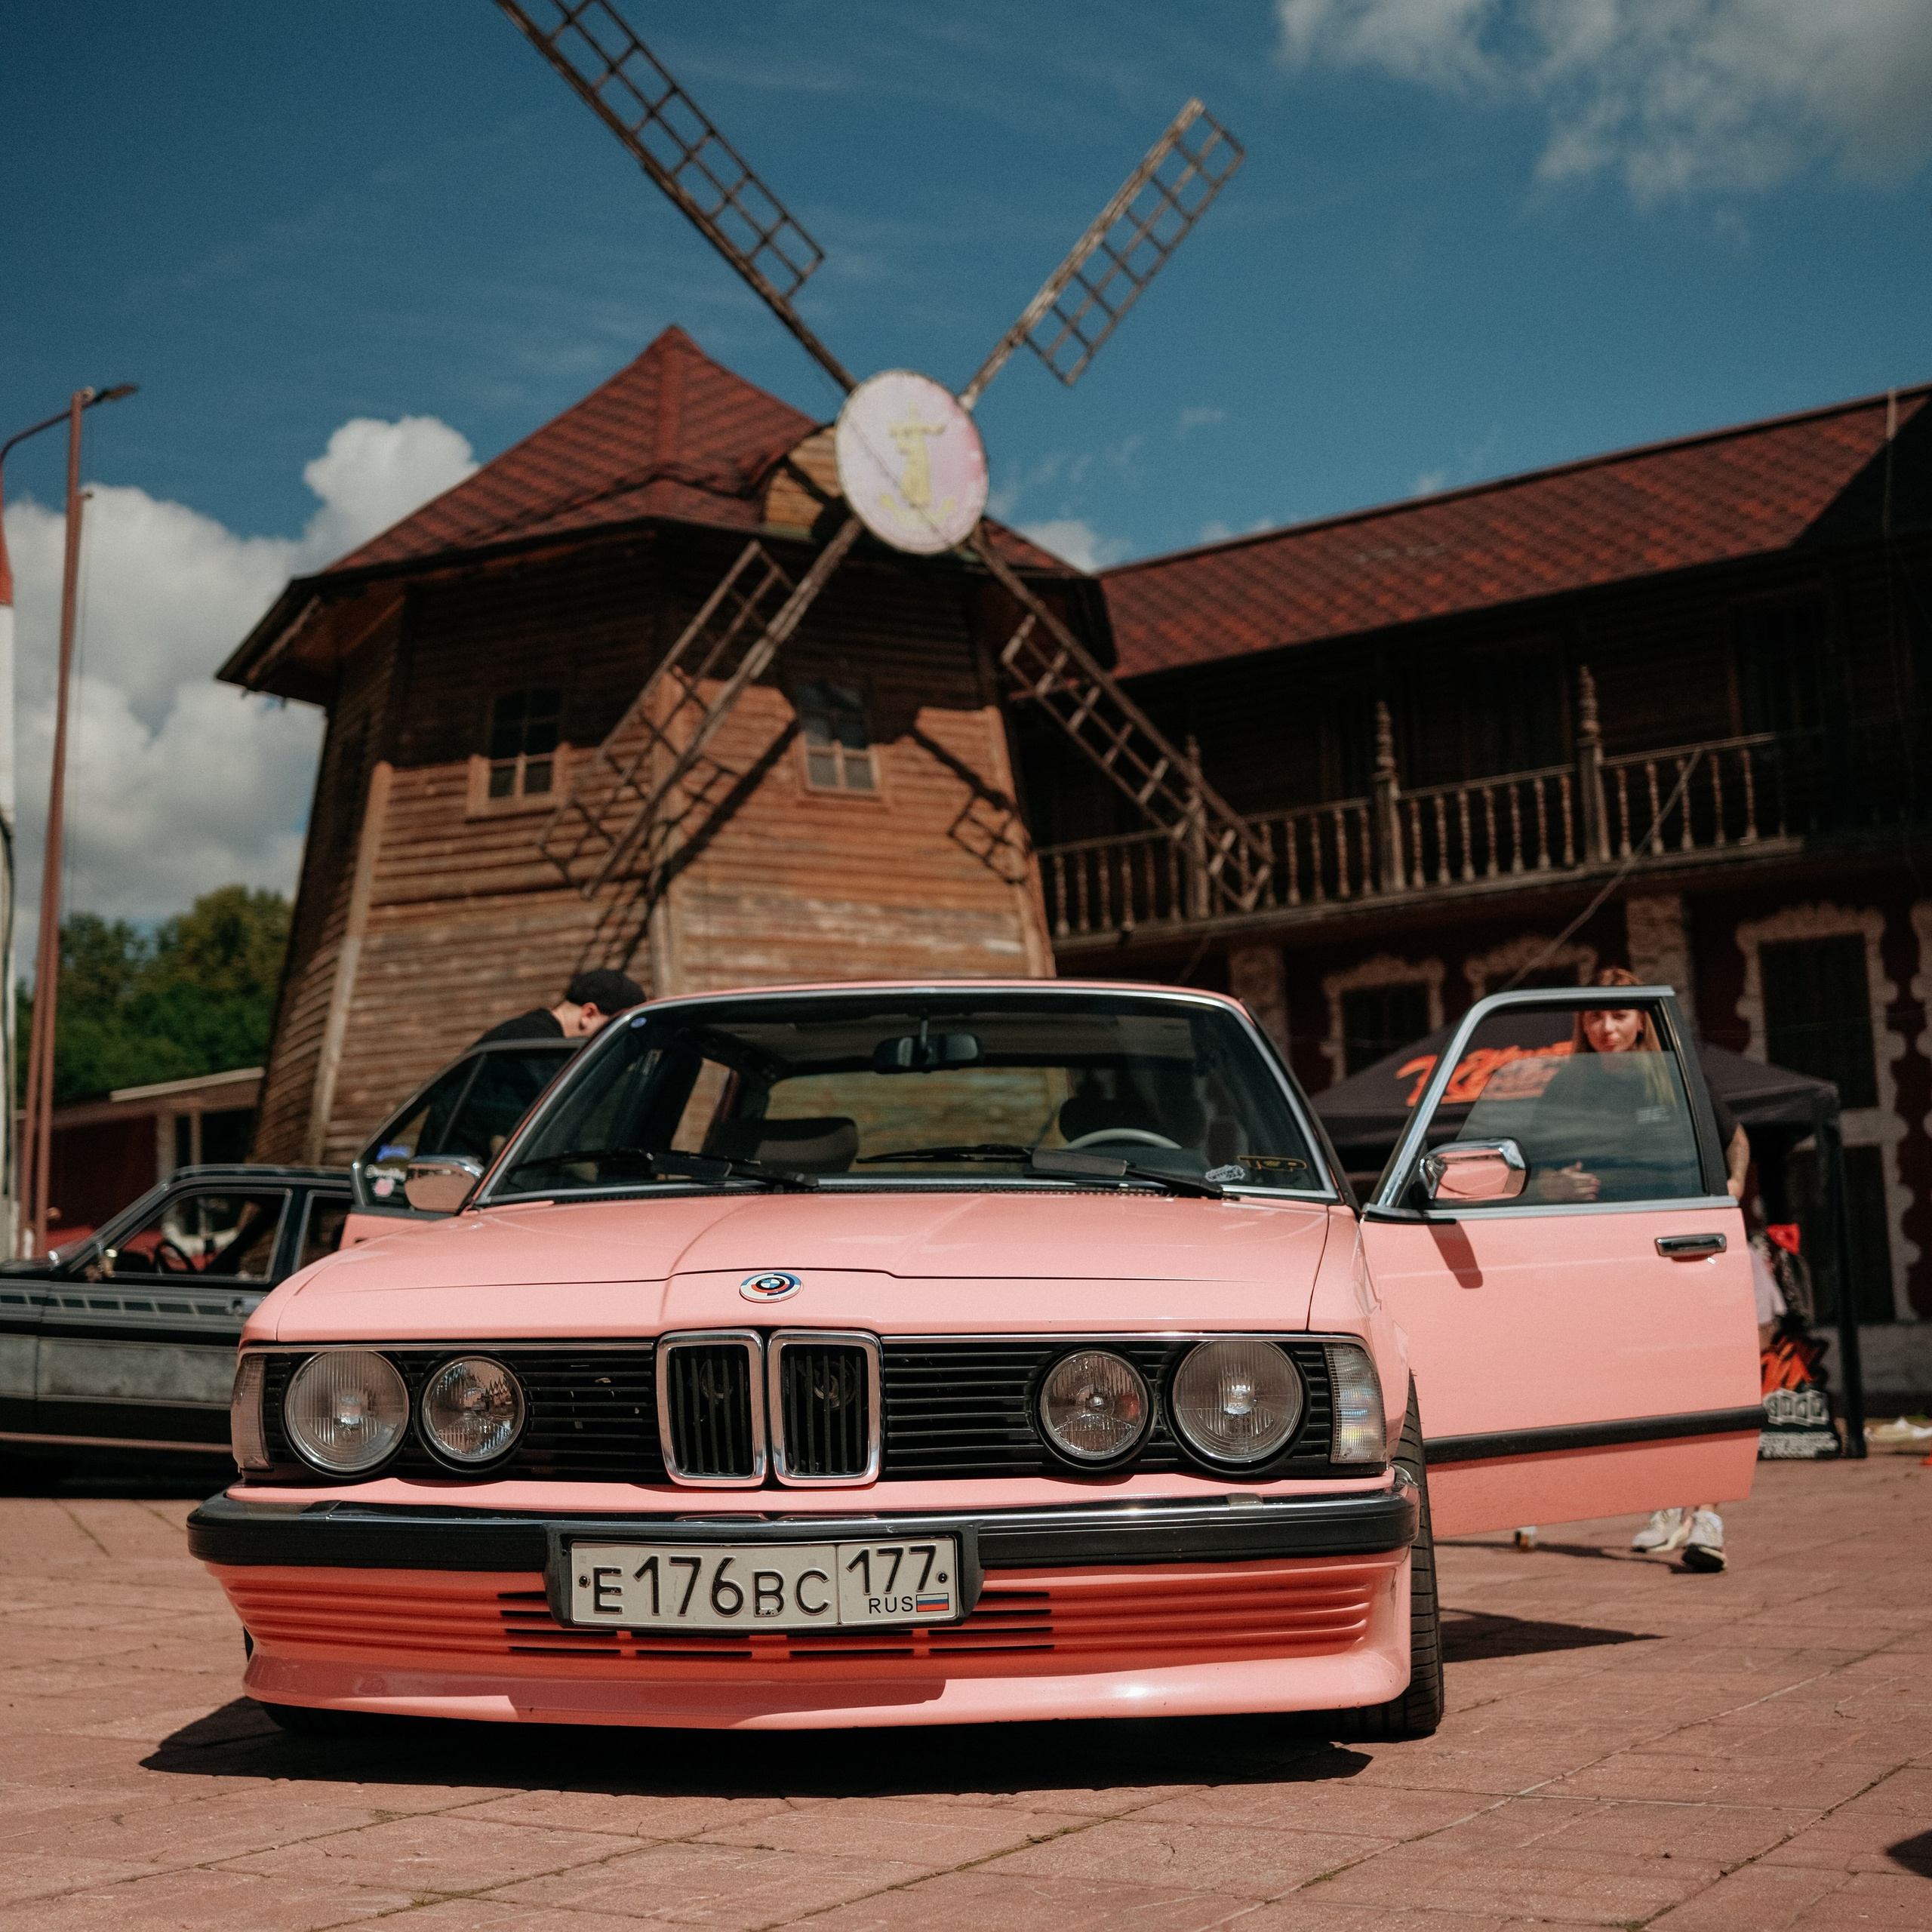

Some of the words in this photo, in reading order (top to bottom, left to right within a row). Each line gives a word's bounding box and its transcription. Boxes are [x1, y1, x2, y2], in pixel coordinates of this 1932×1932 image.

[592, 1554, 830, 1617] E176BC
[846, 1544, 937, 1595] 177
[869, 1595, 914, 1614] RUS
